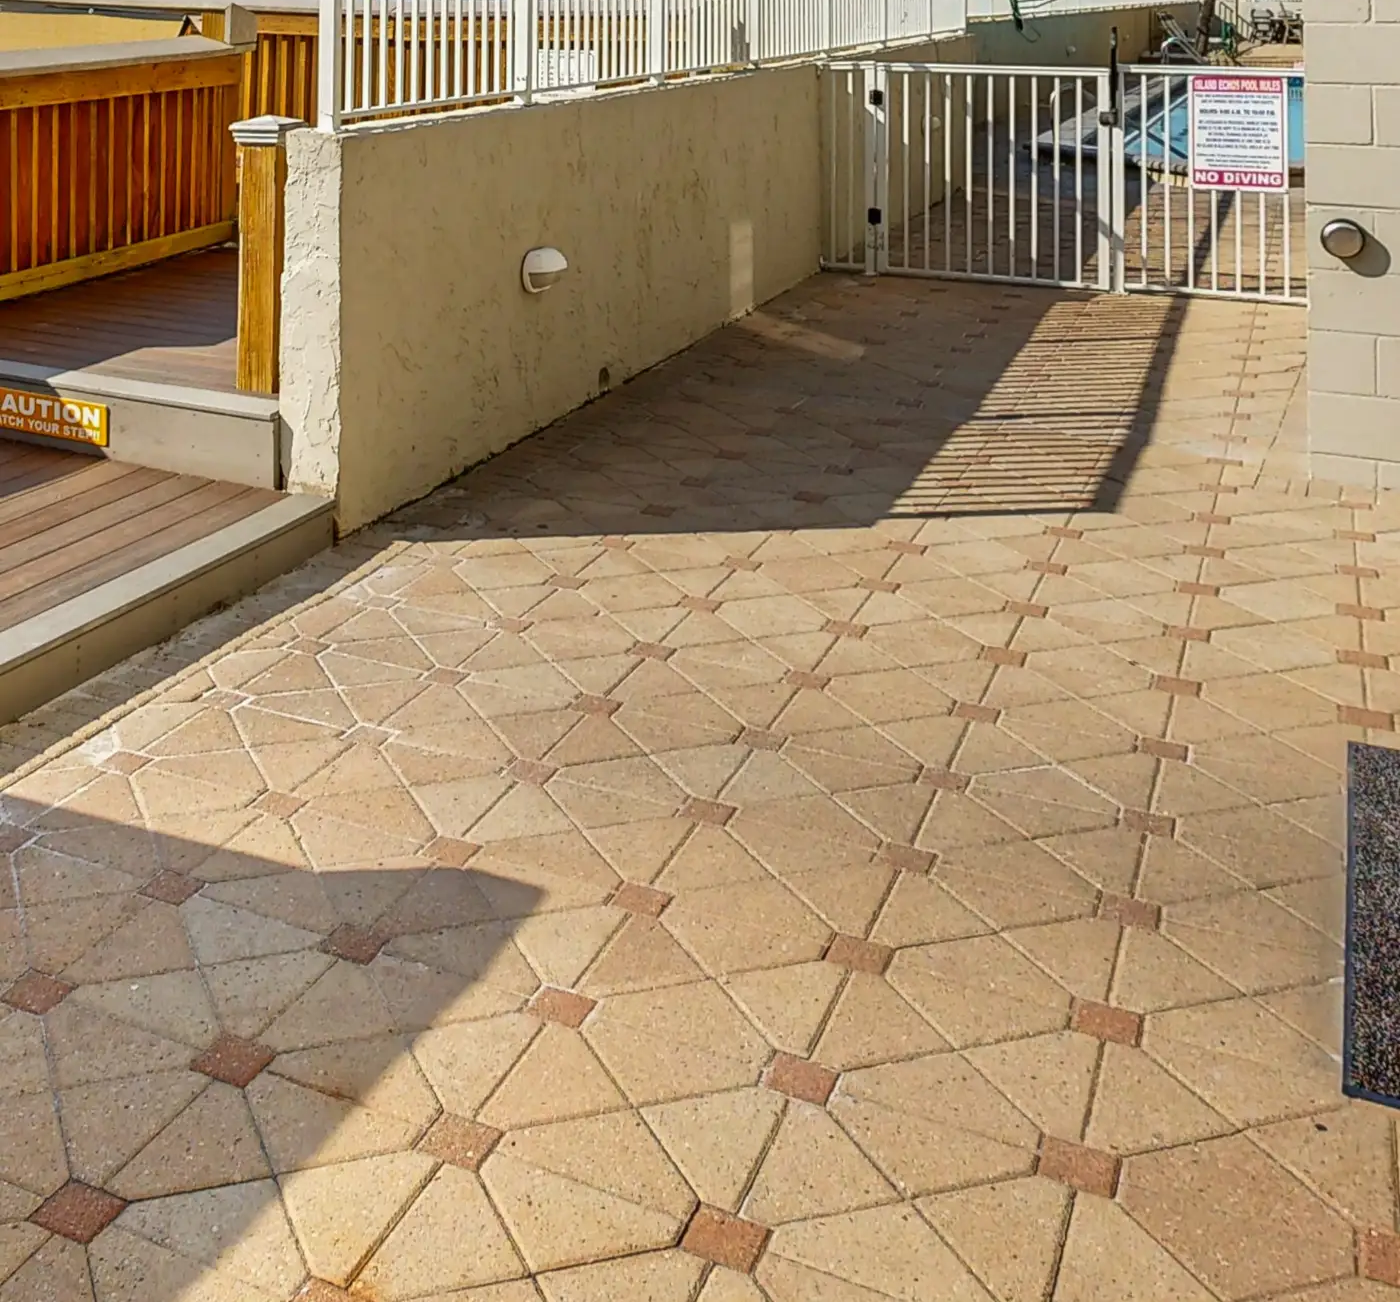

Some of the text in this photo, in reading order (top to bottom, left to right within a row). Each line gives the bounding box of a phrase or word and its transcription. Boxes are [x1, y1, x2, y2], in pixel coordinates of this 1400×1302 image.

[1241, 80, 1259, 91] POOL
[1194, 171, 1219, 183] NO
[0, 393, 100, 428] AUTION
[0, 413, 24, 427] TCH
[27, 418, 60, 434] YOUR
